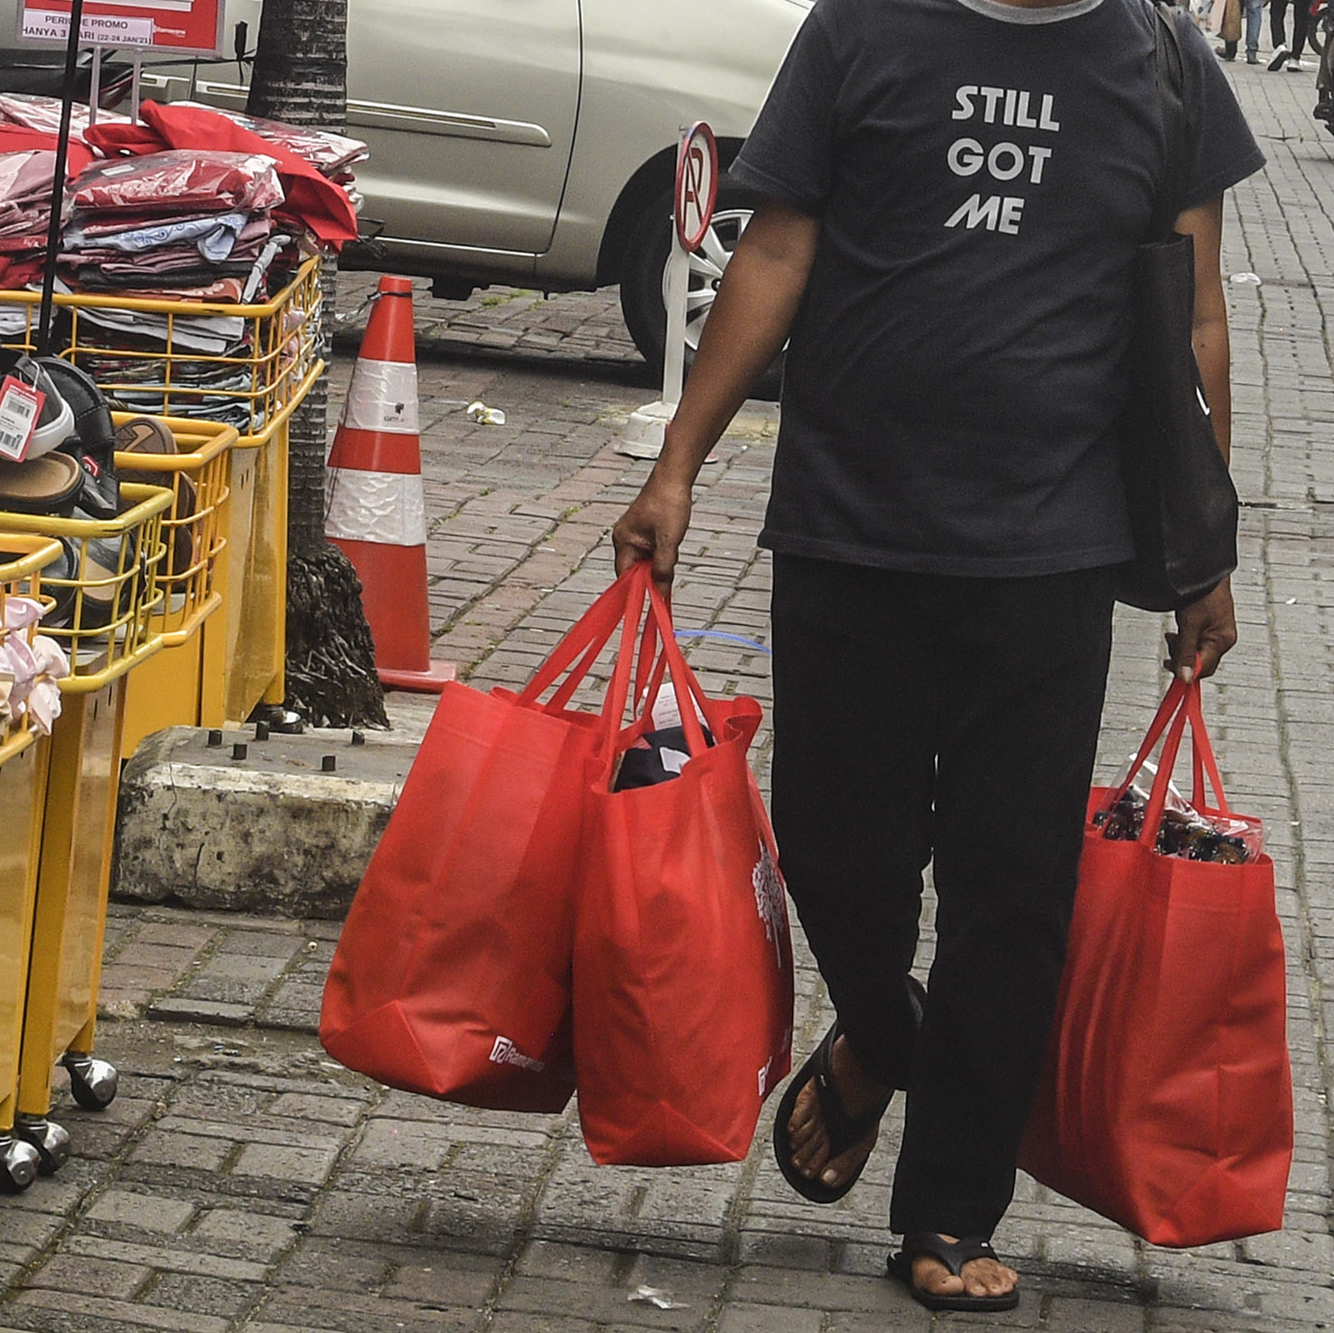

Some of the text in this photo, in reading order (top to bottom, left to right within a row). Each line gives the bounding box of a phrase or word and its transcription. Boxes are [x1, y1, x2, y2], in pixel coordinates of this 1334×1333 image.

[61, 29, 66, 39] 3
[91, 18, 128, 30] PROMO
[952, 85, 1060, 132] STILL
[947, 138, 1052, 184] GOT
[944, 193, 1025, 234] ME
